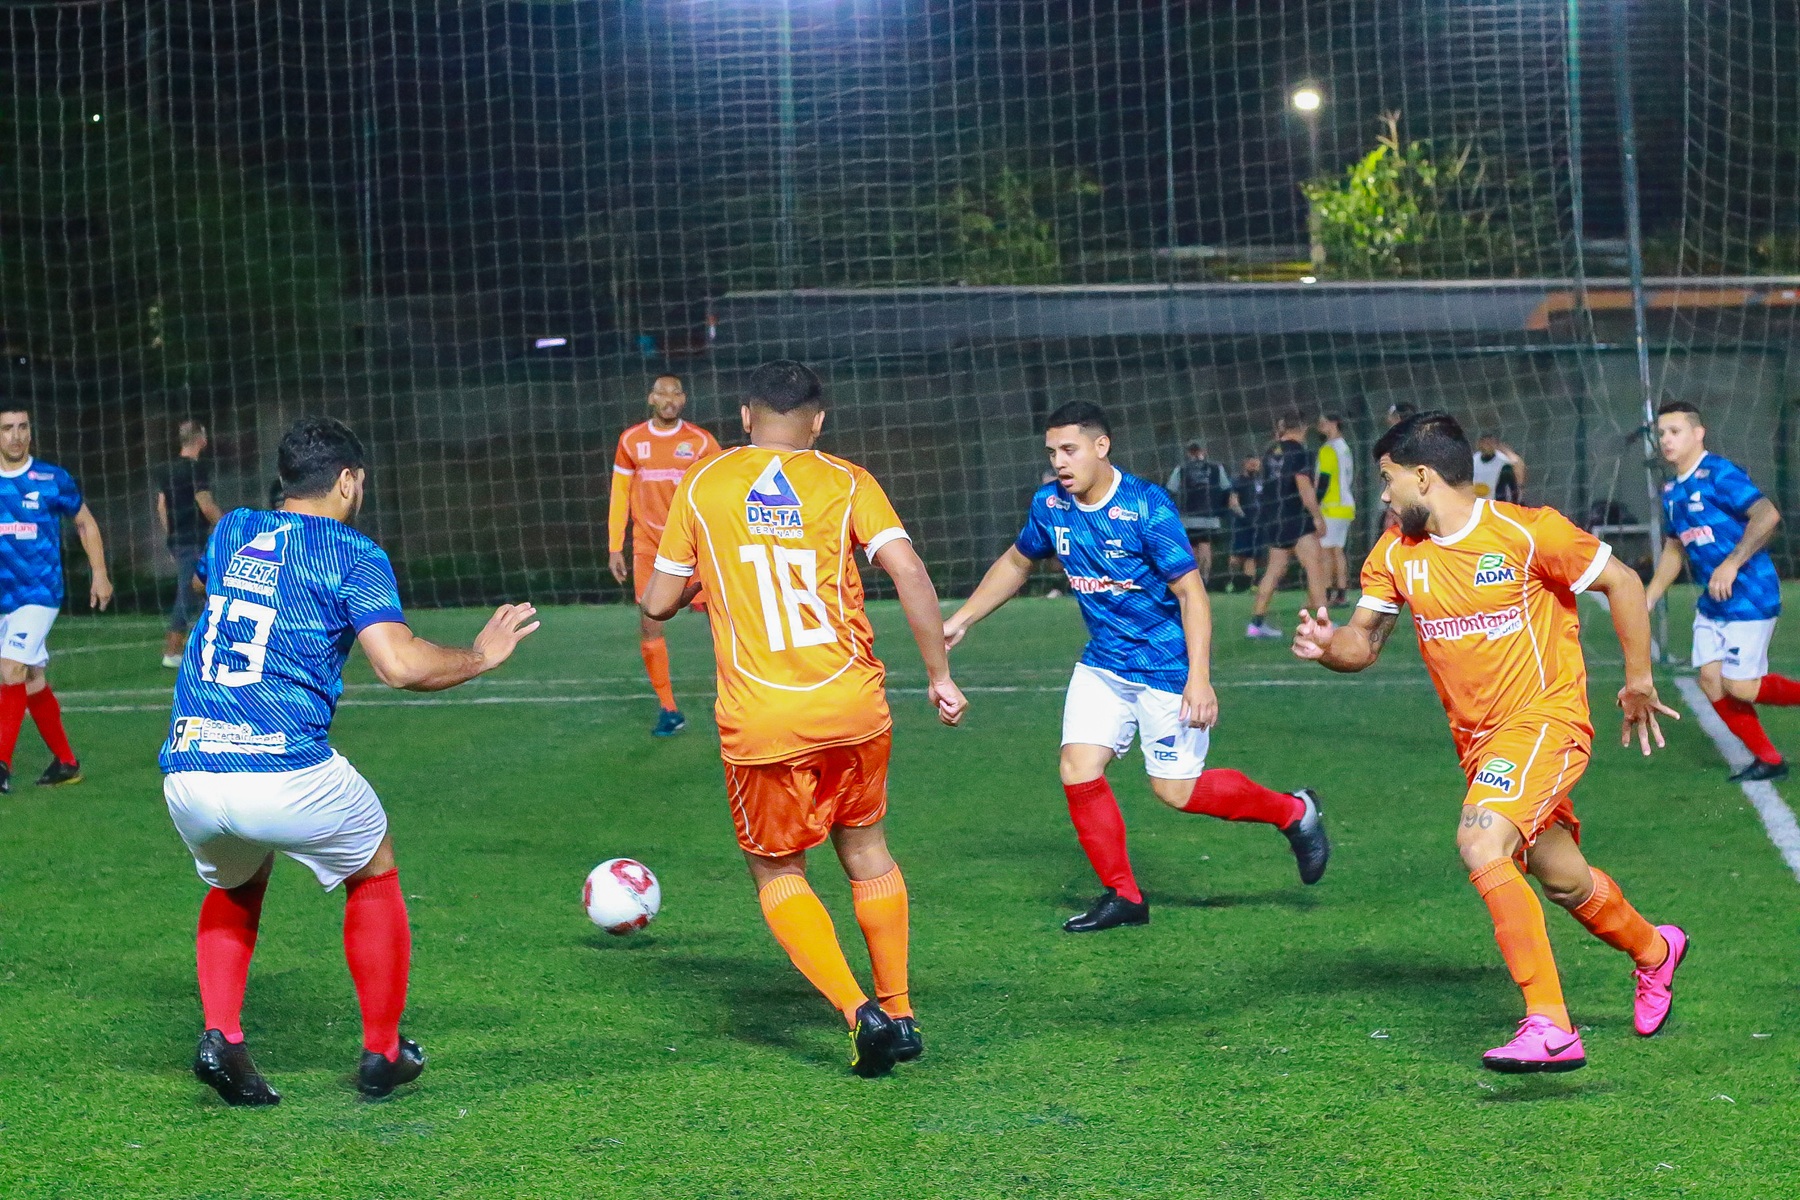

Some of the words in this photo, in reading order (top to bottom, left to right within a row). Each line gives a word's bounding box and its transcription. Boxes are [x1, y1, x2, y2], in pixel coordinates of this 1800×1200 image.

[636, 441, 651, 459] 10
[747, 506, 801, 526] DELTA
[1054, 526, 1070, 555] 16
[228, 559, 278, 584] DELTA
[1404, 559, 1430, 595] 14
[1475, 569, 1515, 585] ADM
[739, 544, 838, 652] 18
[201, 594, 278, 687] 13
[1475, 771, 1511, 792] ADM
[1462, 806, 1494, 829] 96
